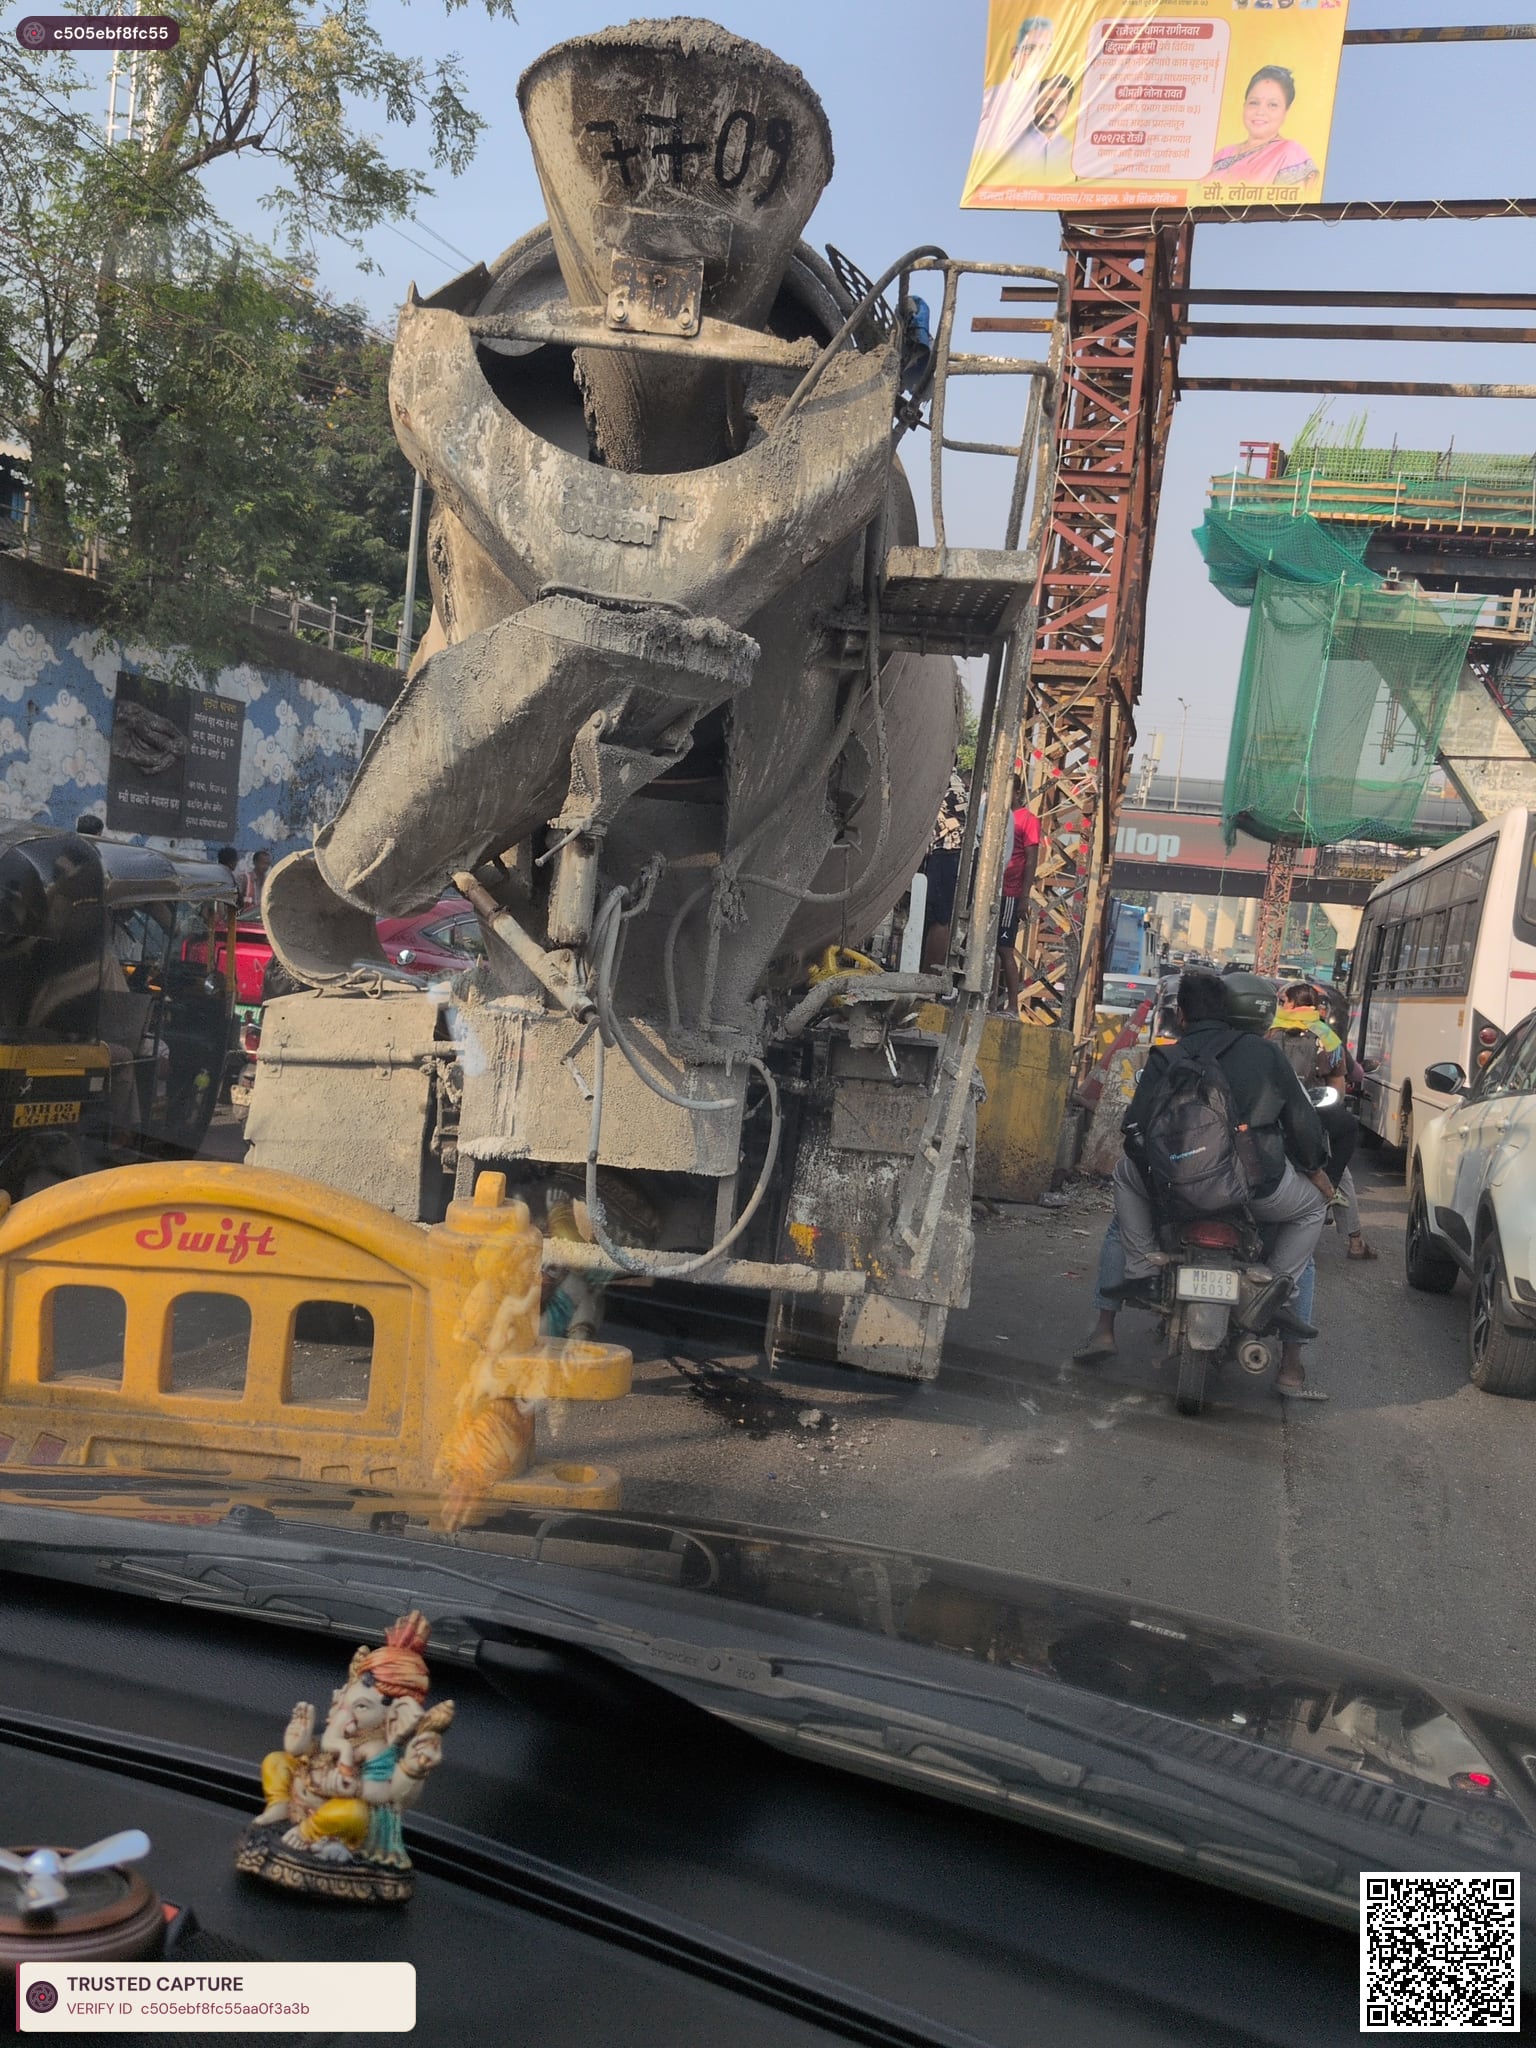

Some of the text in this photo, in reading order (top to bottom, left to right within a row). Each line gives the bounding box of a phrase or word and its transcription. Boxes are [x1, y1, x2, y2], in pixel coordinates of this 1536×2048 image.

[1228, 182, 1264, 201] लोना
[1267, 186, 1300, 201] रावत
[135, 1211, 279, 1265] Swift
